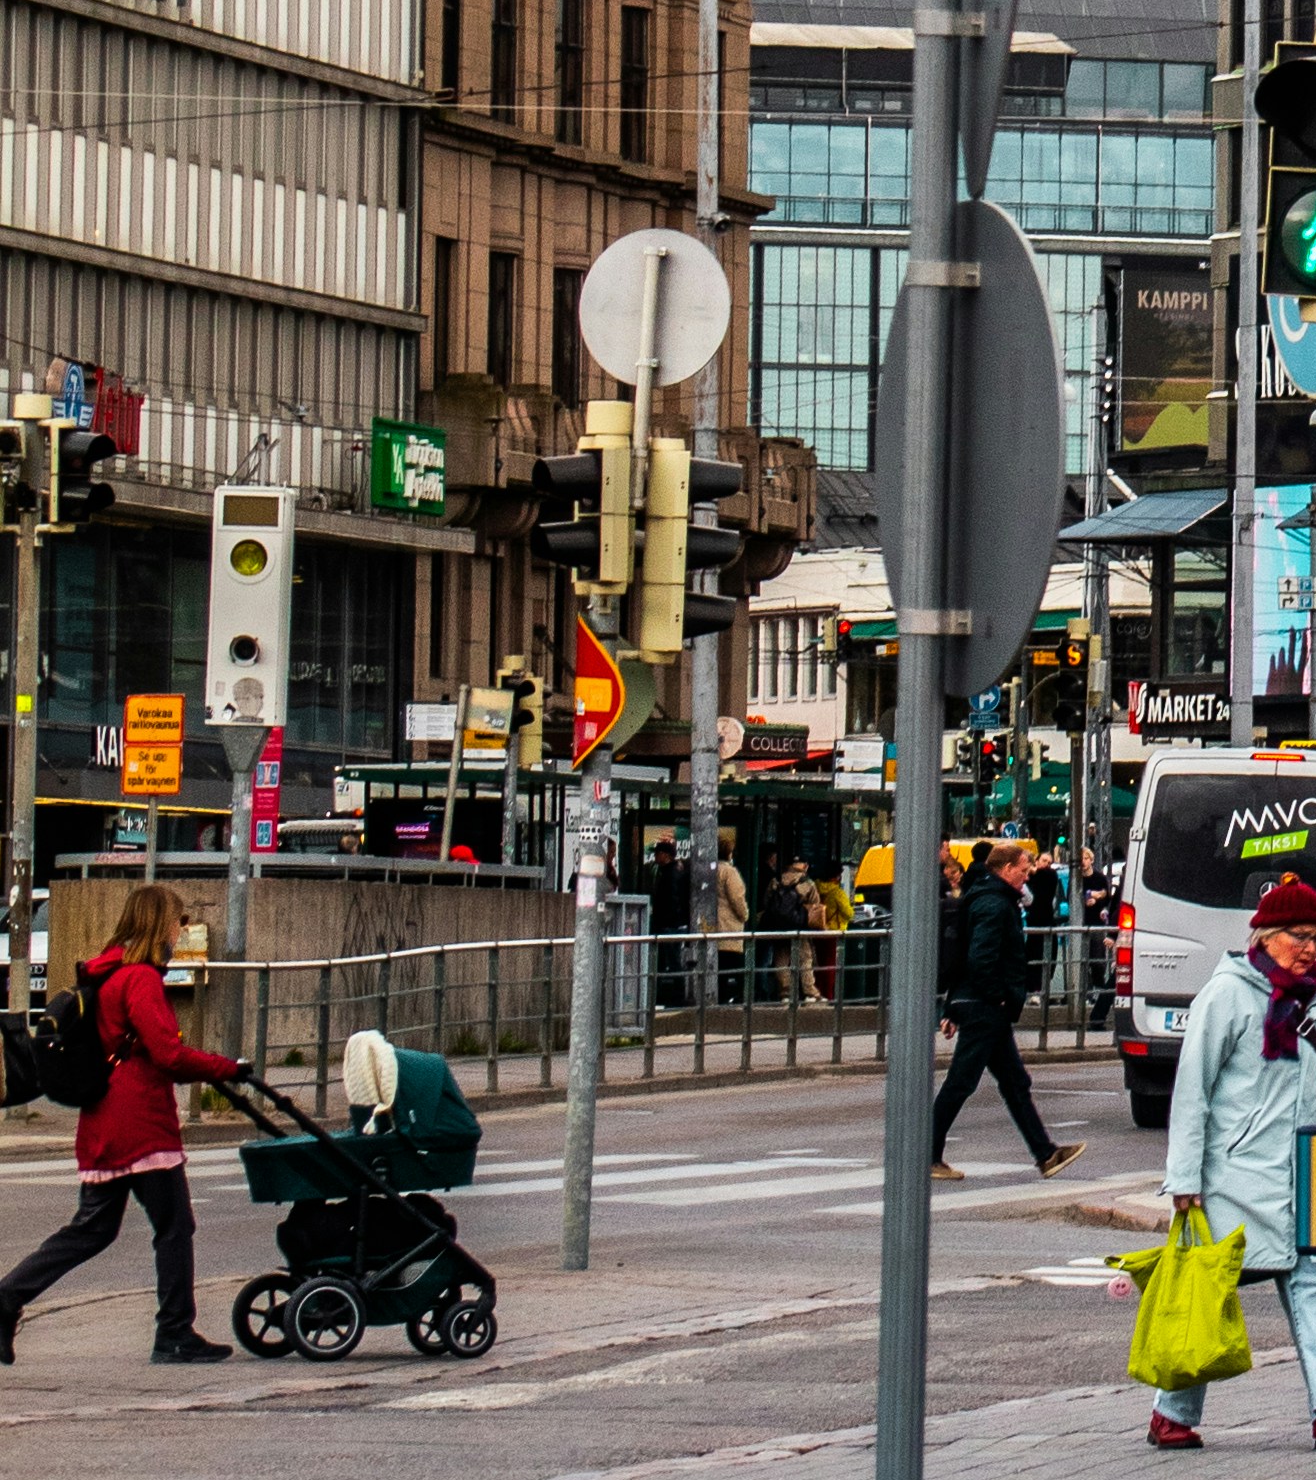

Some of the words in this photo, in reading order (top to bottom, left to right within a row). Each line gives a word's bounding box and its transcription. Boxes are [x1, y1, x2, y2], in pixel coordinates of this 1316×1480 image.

[1137, 289, 1208, 311] KAMPPI
[137, 708, 173, 719] Varokaa
[1147, 694, 1217, 724] MARKET
[129, 720, 180, 731] raitiovaunua
[138, 751, 150, 762] Se
[127, 775, 176, 788] spårvagnen
[1252, 835, 1298, 854] TAKSI
